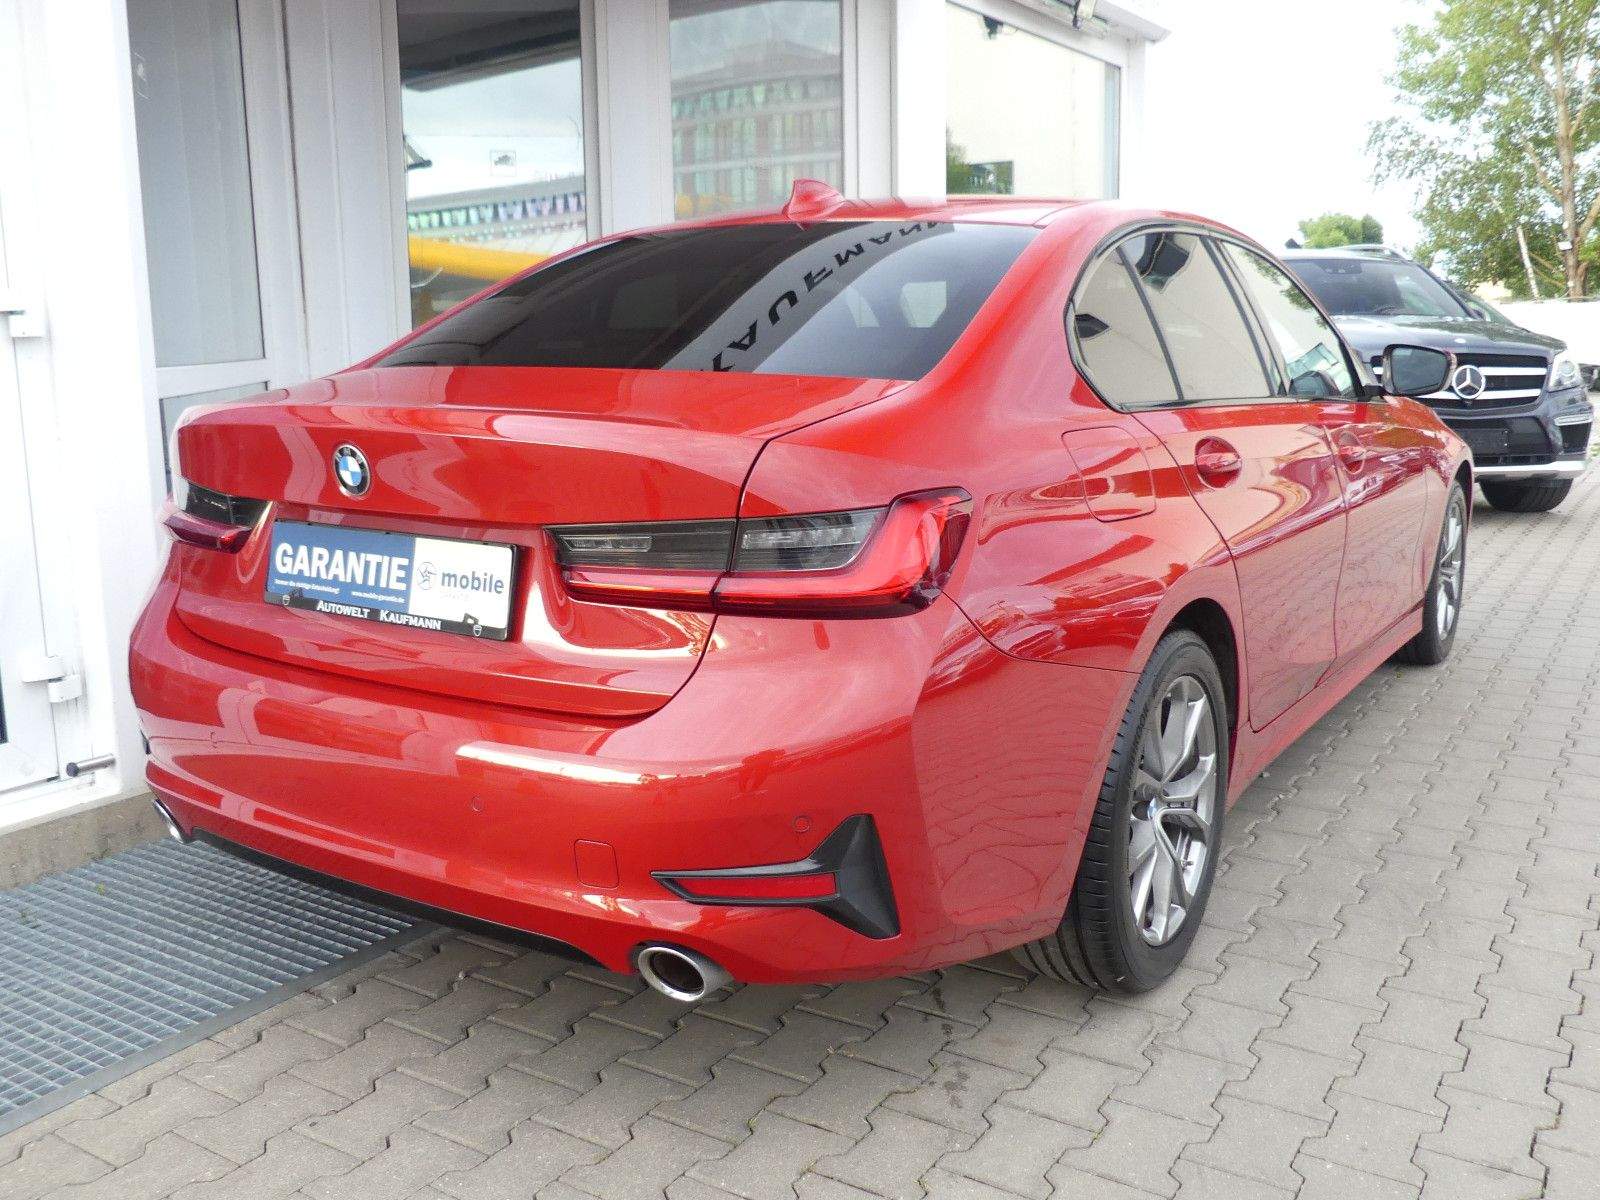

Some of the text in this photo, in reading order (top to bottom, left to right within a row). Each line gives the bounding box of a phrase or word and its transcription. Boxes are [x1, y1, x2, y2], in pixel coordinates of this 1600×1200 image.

[275, 542, 409, 590] GARANTIE
[441, 570, 504, 594] mobile
[316, 600, 442, 630] AUTOWELT KAUFMANN
